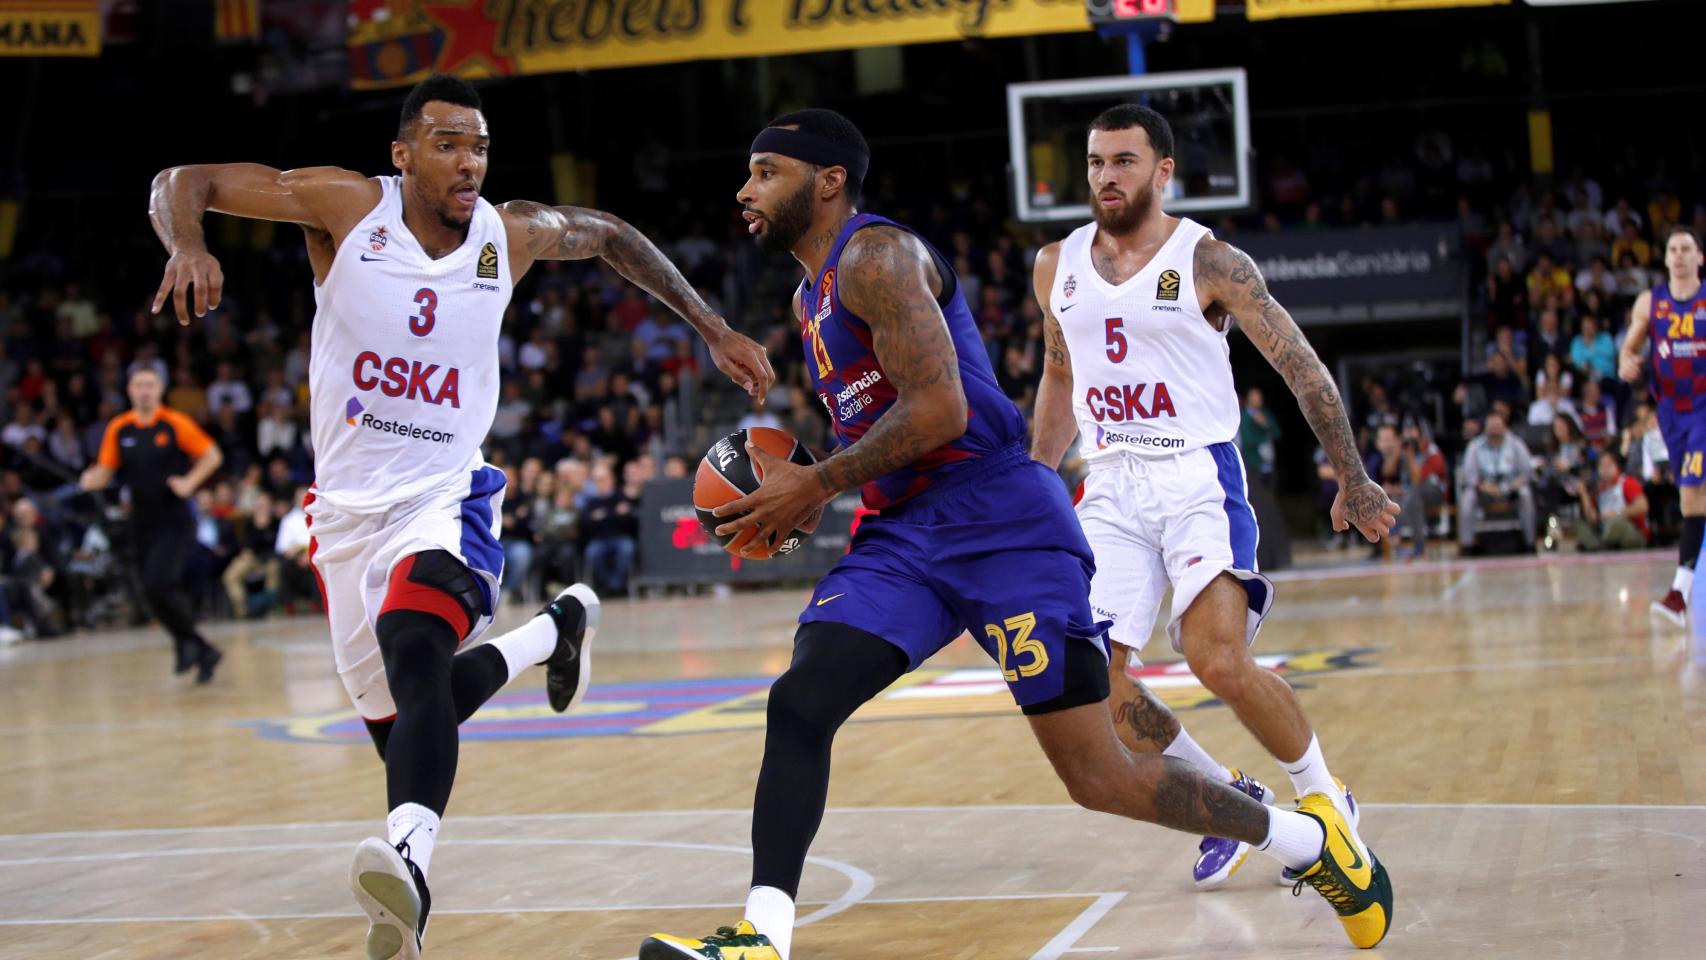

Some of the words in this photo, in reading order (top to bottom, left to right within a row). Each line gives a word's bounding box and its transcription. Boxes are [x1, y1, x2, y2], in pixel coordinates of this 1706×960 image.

[408, 287, 438, 337] 3
[1152, 304, 1182, 313] oneteam
[1667, 312, 1695, 339] 24
[1105, 317, 1128, 364] 5
[353, 351, 460, 409] CSKA
[1085, 381, 1177, 422] CSKA
[361, 413, 455, 444] Rostelecom
[1105, 431, 1185, 449] Rostelecom
[984, 611, 1050, 682] 23
